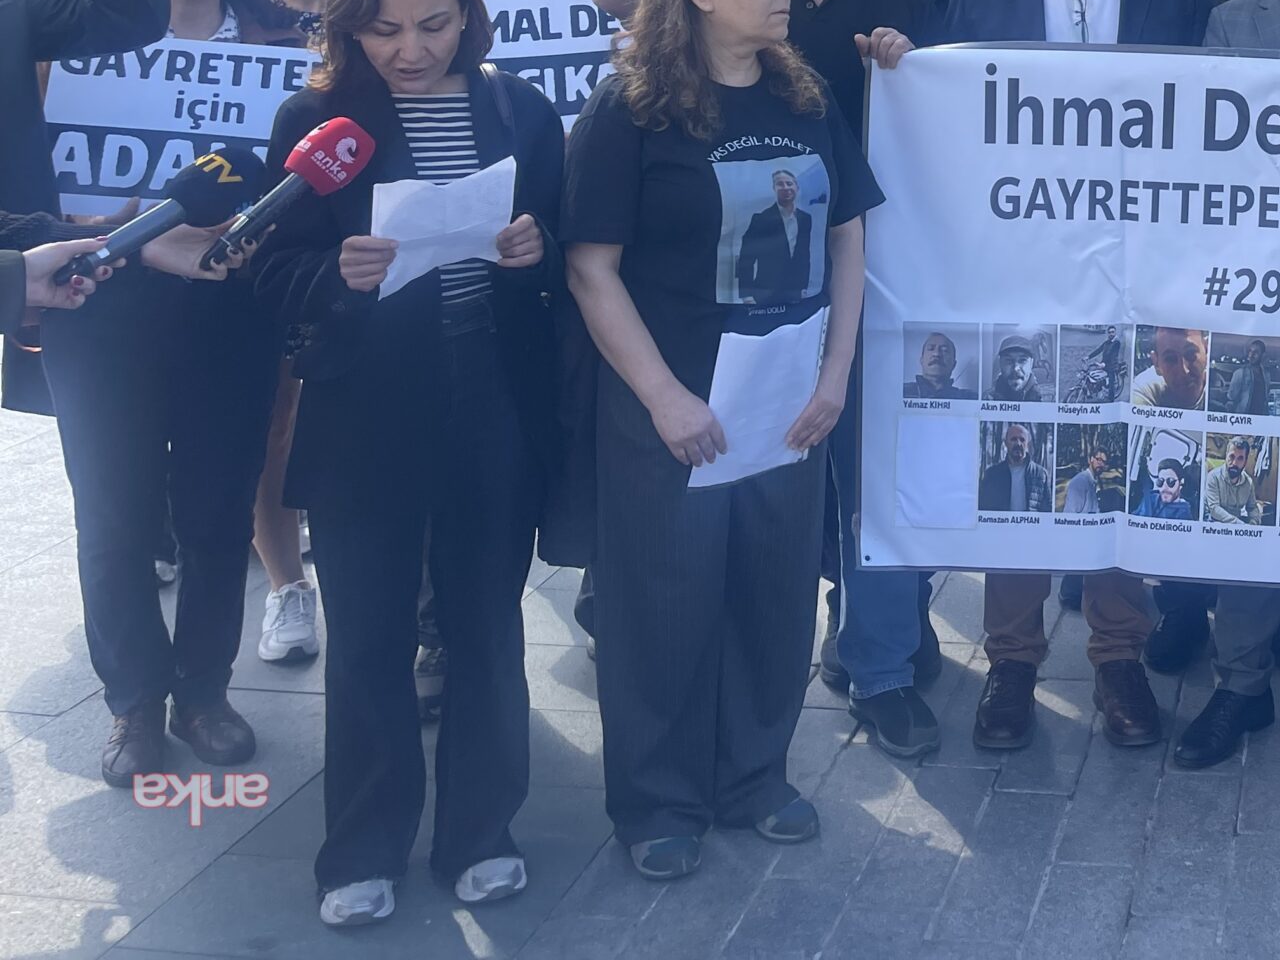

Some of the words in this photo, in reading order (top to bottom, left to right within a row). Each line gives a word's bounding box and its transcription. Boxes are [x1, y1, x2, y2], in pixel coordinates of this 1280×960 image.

[174, 91, 245, 130] için
[984, 62, 1176, 150] İhmal
[707, 144, 728, 163] YAS
[726, 136, 762, 153] DEĞİL
[765, 137, 813, 154] ADALET
[314, 150, 347, 180] anka
[990, 176, 1280, 229] GAYRETTEPE
[981, 403, 998, 412] Akın
[1058, 405, 1088, 416] Hüseyin
[1090, 406, 1100, 414] AK
[1132, 406, 1156, 419] Cengiz
[1157, 410, 1183, 419] AKSOY
[1229, 416, 1252, 425] ÇAYIR
[1010, 516, 1040, 524] ALPHAN
[1100, 517, 1115, 525] KAYA
[1150, 519, 1192, 533] DEMİROĞLU
[1235, 528, 1262, 538] KORKUT
